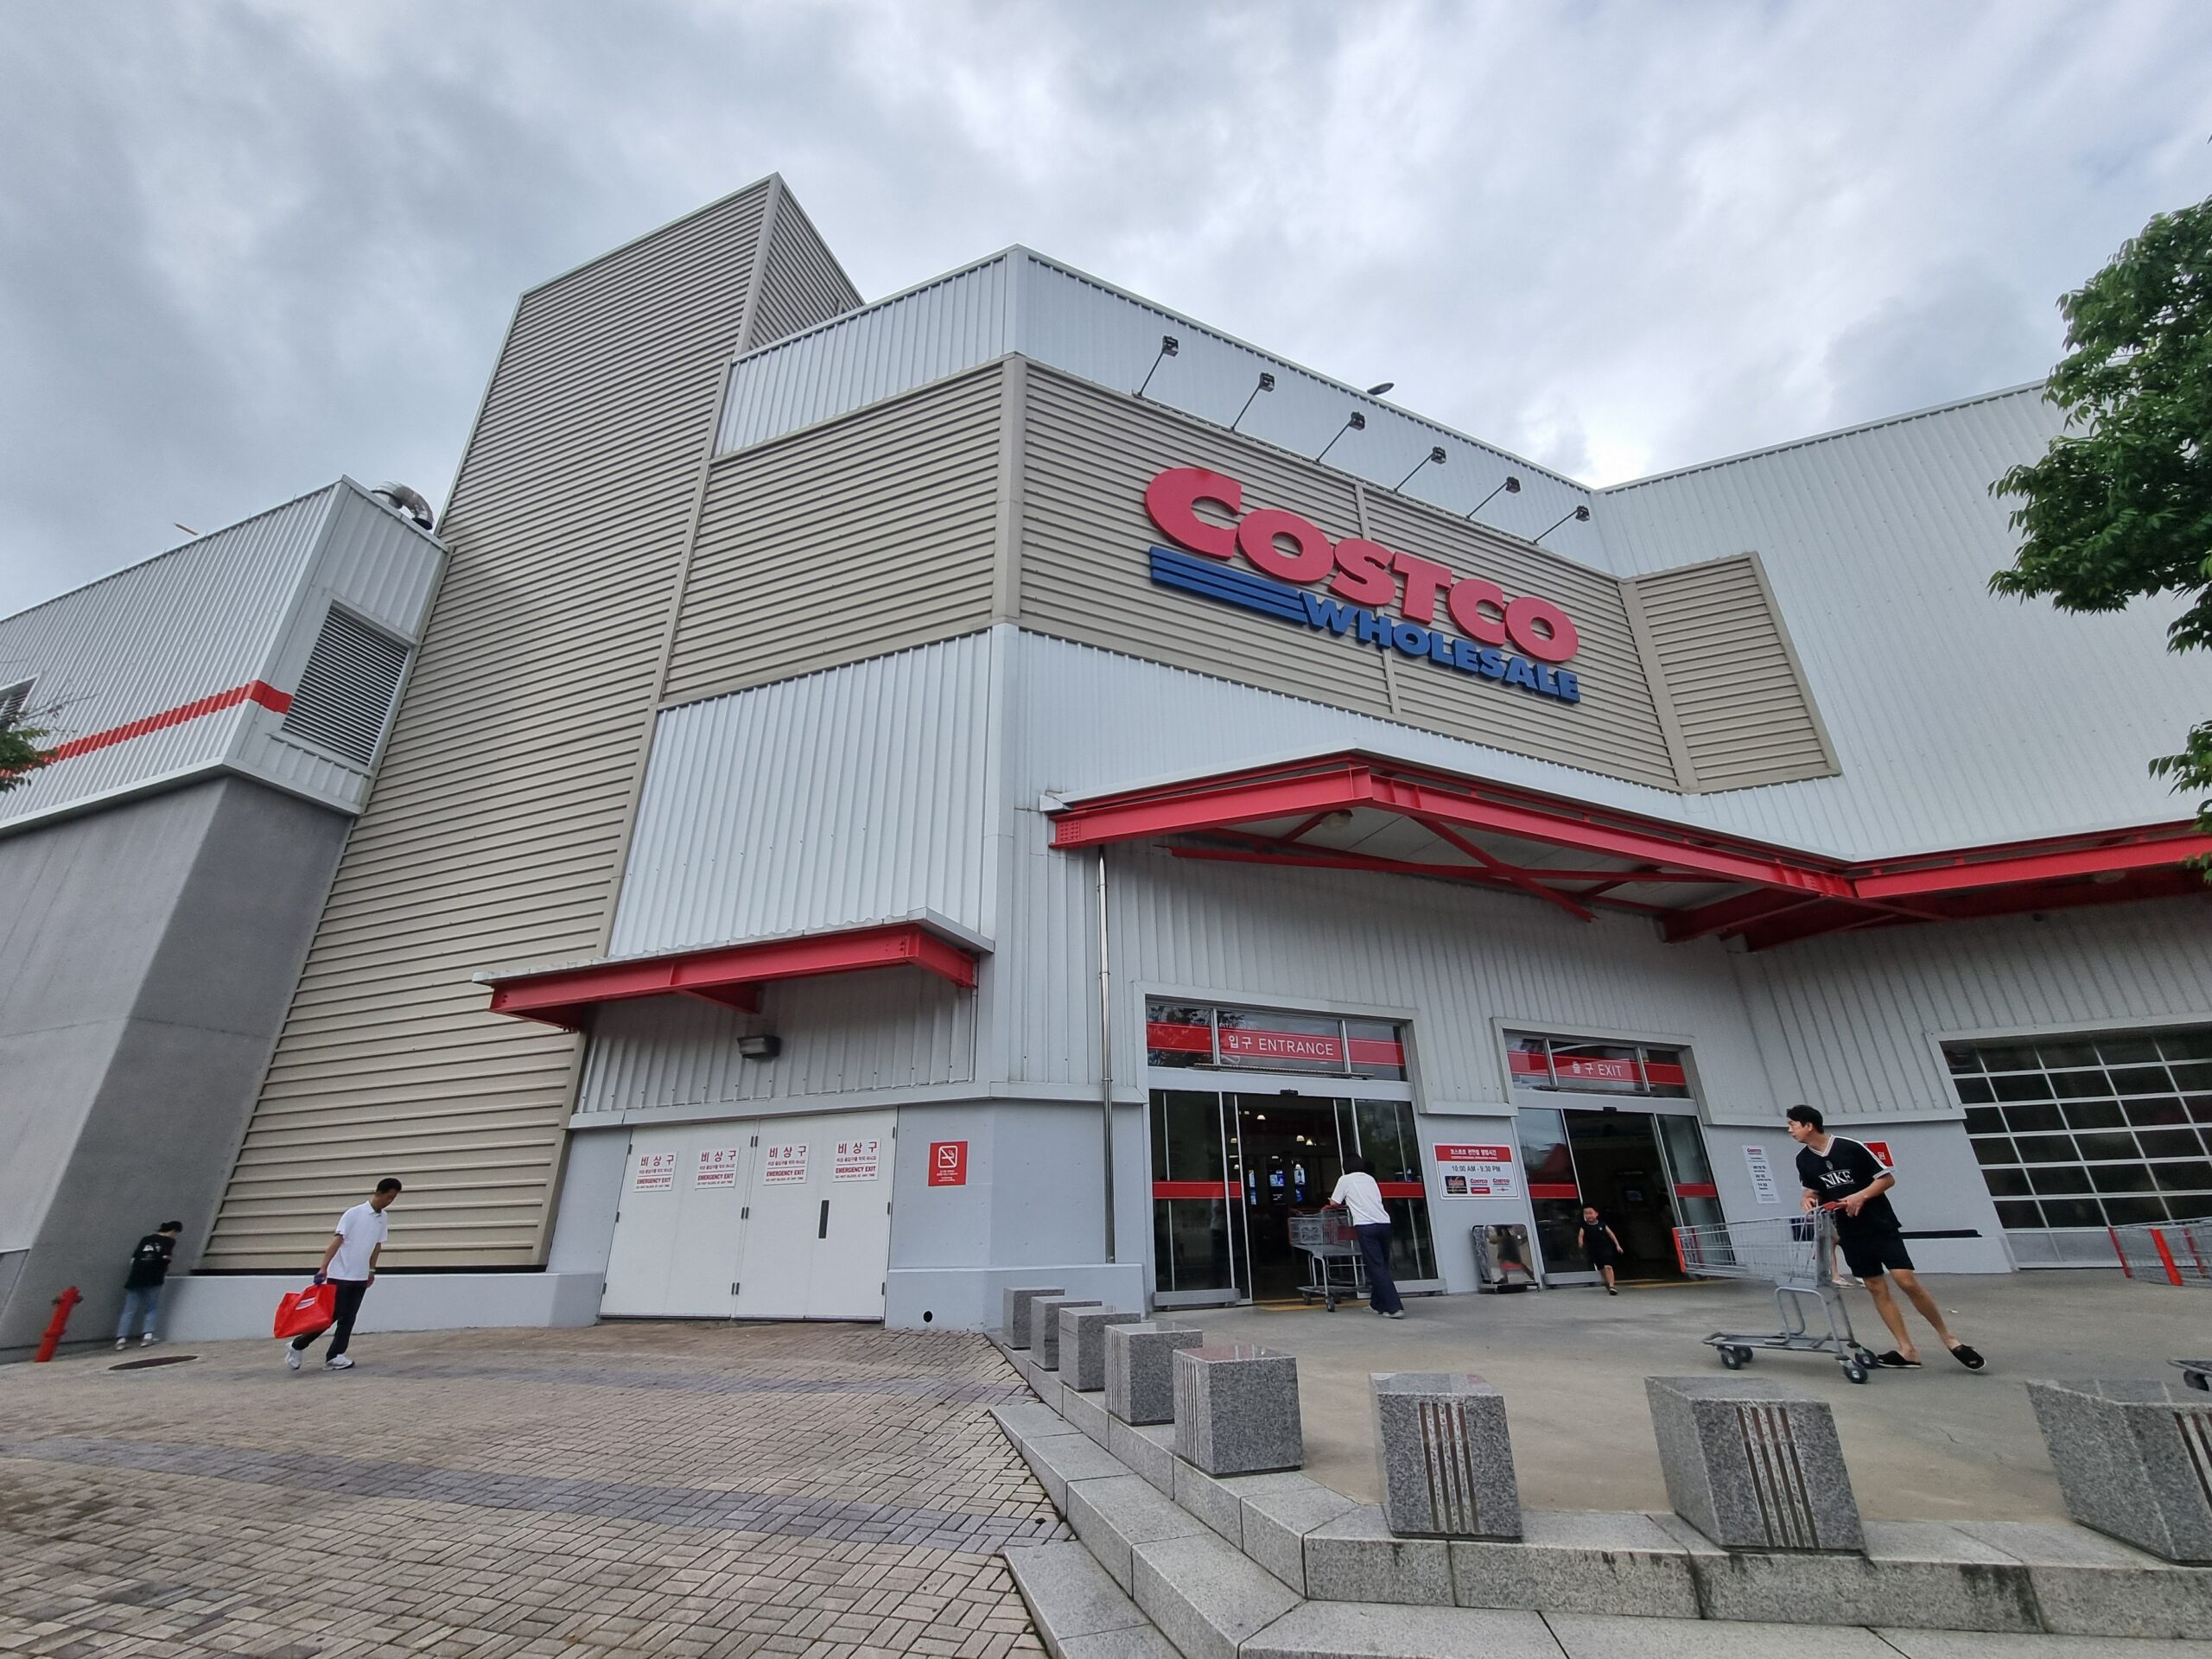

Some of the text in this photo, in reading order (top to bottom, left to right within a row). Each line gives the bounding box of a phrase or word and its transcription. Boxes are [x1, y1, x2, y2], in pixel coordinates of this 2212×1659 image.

[1144, 467, 1579, 663] COSTCO
[1299, 591, 1580, 704] WHOLESALE
[1228, 1034, 1334, 1056] 입구 ENTRANCE
[1598, 1064, 1622, 1077] EXIT
[1821, 1171, 1853, 1188] NIKE
